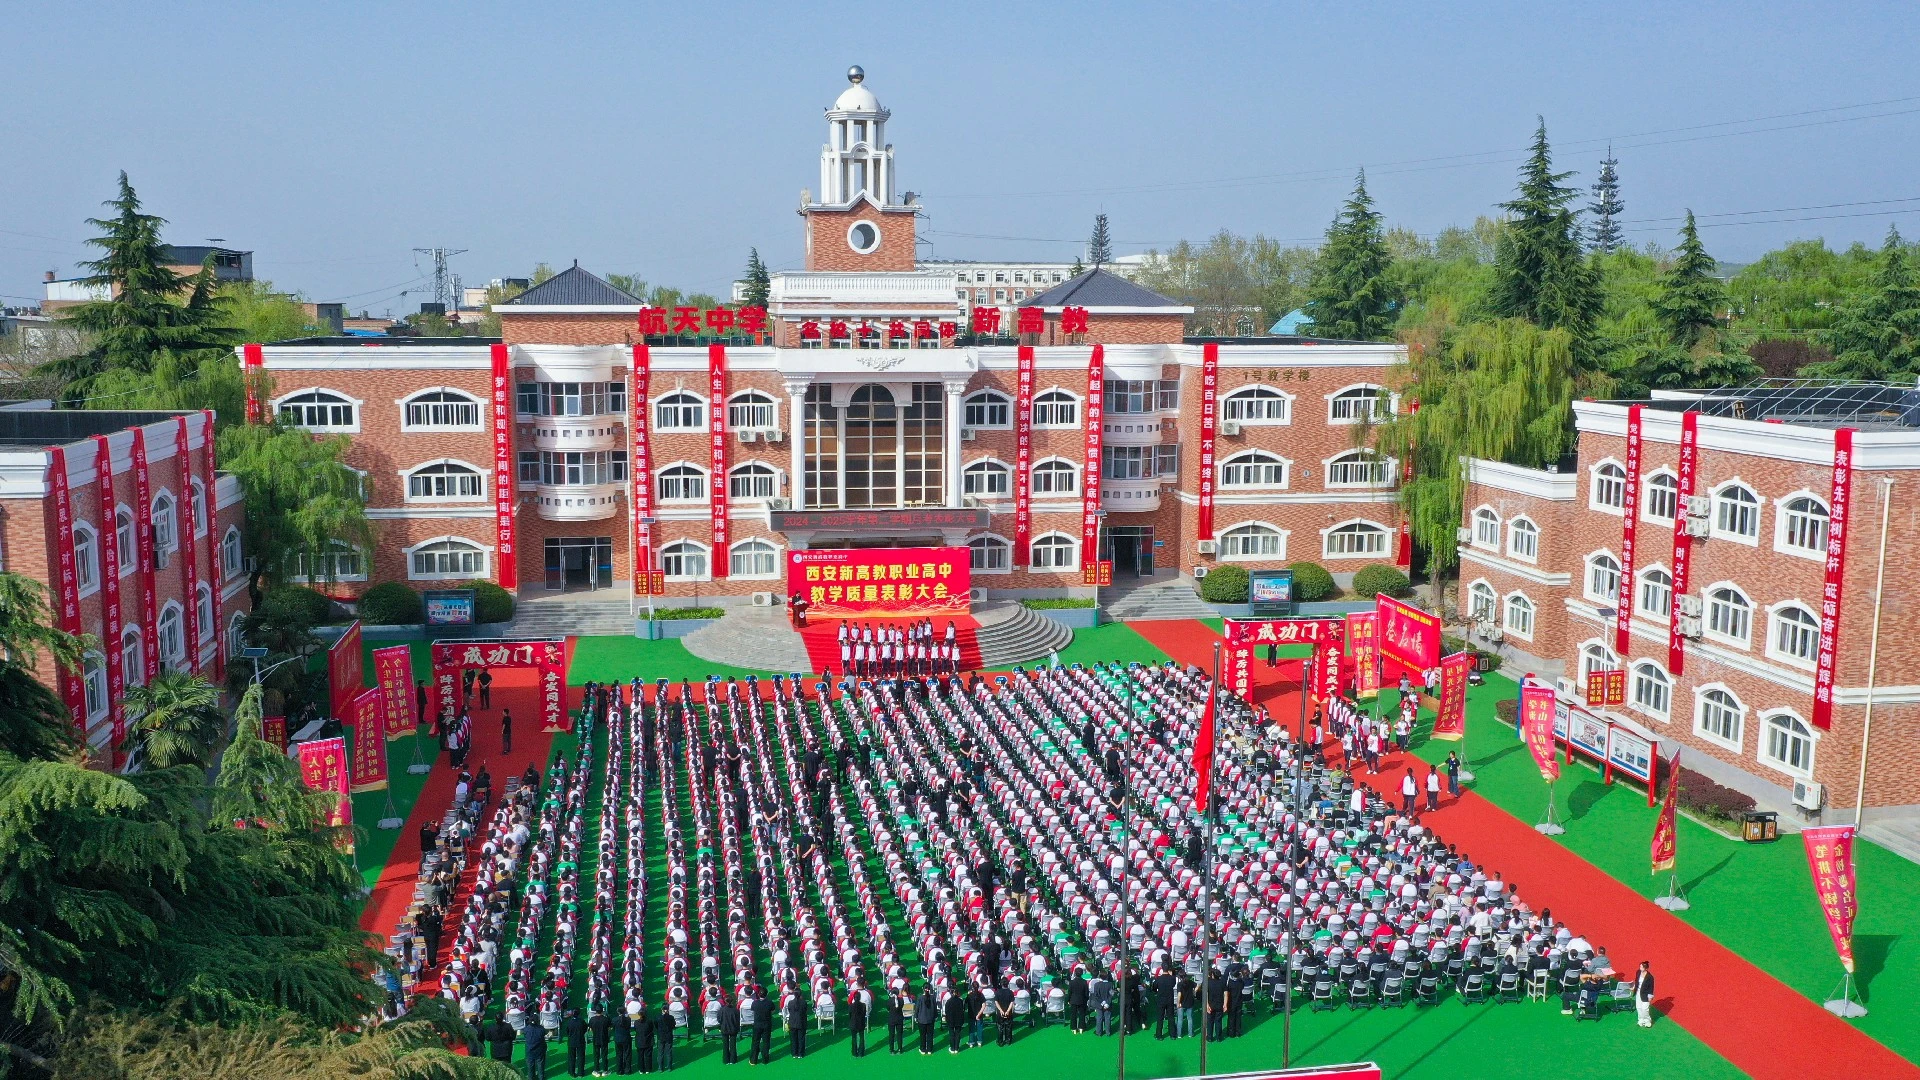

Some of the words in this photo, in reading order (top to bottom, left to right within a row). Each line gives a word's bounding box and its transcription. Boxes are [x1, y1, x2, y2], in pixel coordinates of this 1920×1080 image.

[638, 305, 768, 333] 航天中学
[972, 306, 1089, 333] 新高教
[1202, 361, 1216, 429] 宁吃百日苦
[1243, 369, 1310, 381] 1号教学楼
[495, 376, 511, 553] 梦想和现实之间的距离是行动
[1084, 367, 1101, 538] 不起眼的坏习惯是无底的漏斗
[1201, 439, 1213, 508] 不留终身憾
[1624, 423, 1638, 529] 觉得为时已晚的时候
[1677, 430, 1693, 536] 星光不负赶路人
[56, 472, 69, 541] 见贤思齐
[1827, 450, 1848, 573] 表彰先进树标杆
[61, 553, 75, 619] 对标卓越
[806, 562, 953, 581] 西安新高教职业高中
[810, 582, 948, 602] 教学质量表彰大会
[1618, 539, 1632, 631] 恰恰是最早的时候
[462, 645, 534, 665] 成功门
[1257, 621, 1319, 642] 成功门
[1816, 582, 1838, 704] 砥砺奋进创辉煌
